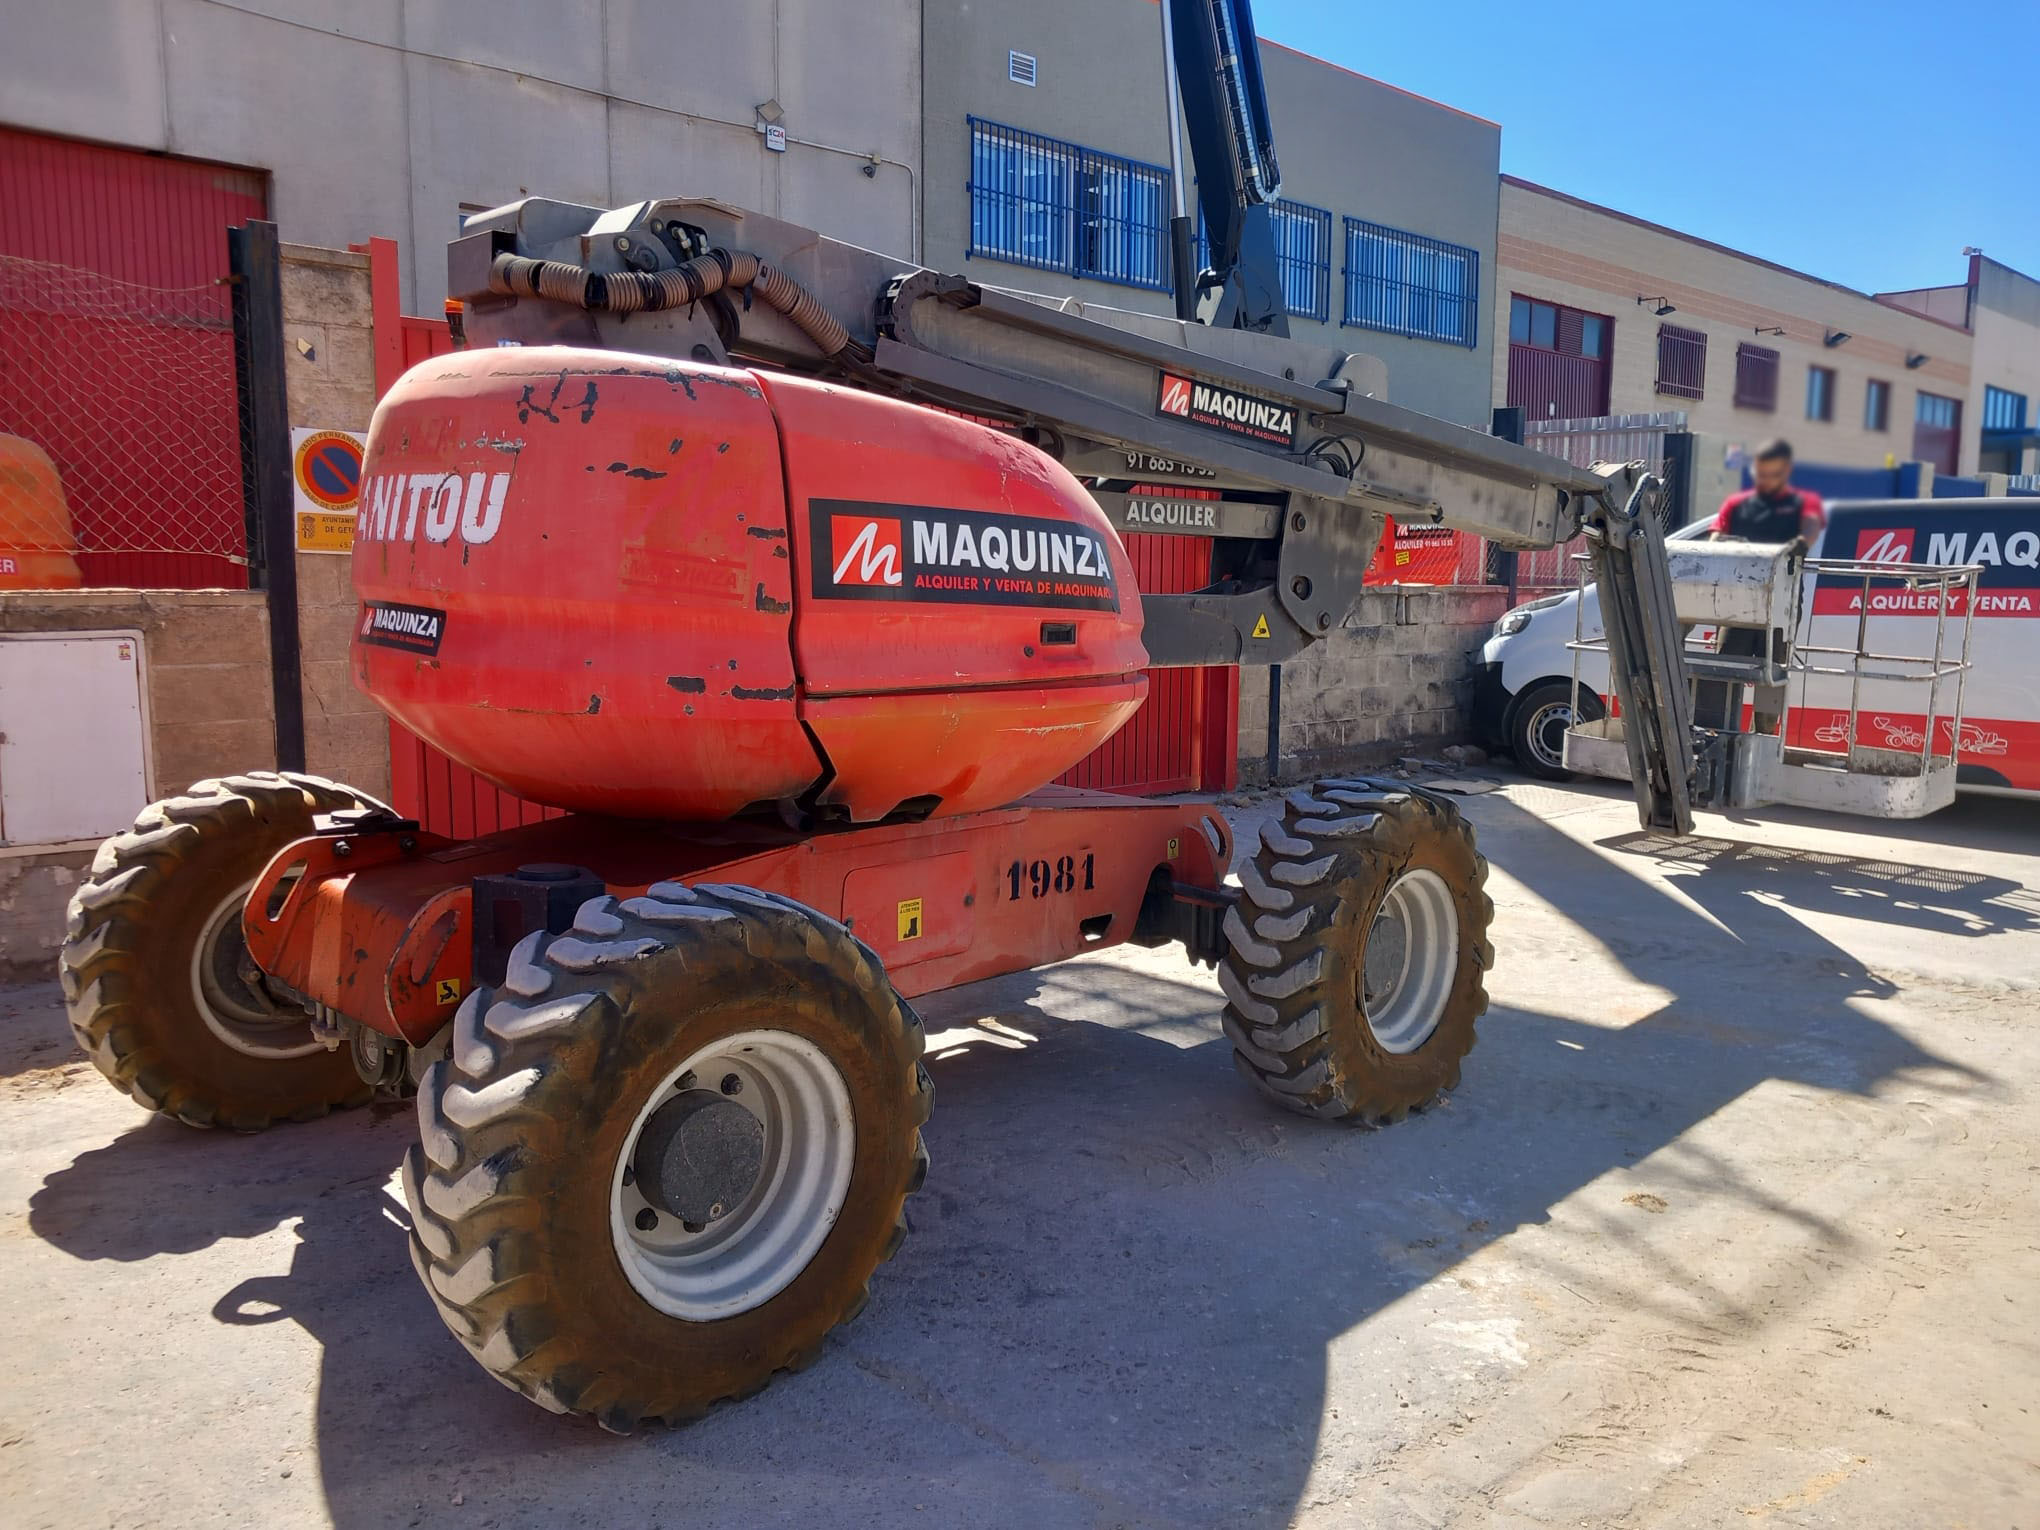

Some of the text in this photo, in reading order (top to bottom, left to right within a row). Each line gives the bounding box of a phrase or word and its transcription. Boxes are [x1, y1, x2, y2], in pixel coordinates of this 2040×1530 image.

[1193, 386, 1292, 435] MAQUINZA
[1192, 413, 1219, 426] ALQUILER
[1227, 423, 1244, 433] VENTA
[1128, 452, 1143, 468] 91
[1127, 501, 1215, 527] ALQUILER
[913, 520, 1111, 581] MAQUINZA
[1394, 540, 1423, 550] ALQUILER
[1926, 531, 2040, 568] MAQ
[0, 559, 15, 573] R
[915, 575, 978, 591] ALQUILER
[982, 577, 991, 591] Y
[996, 578, 1033, 593] VENTA
[1037, 582, 1051, 594] DE
[1849, 595, 1938, 610] AQUILER
[1946, 597, 1960, 610] Y
[374, 608, 438, 638] MAQUINZA
[1007, 853, 1095, 901] 1981
